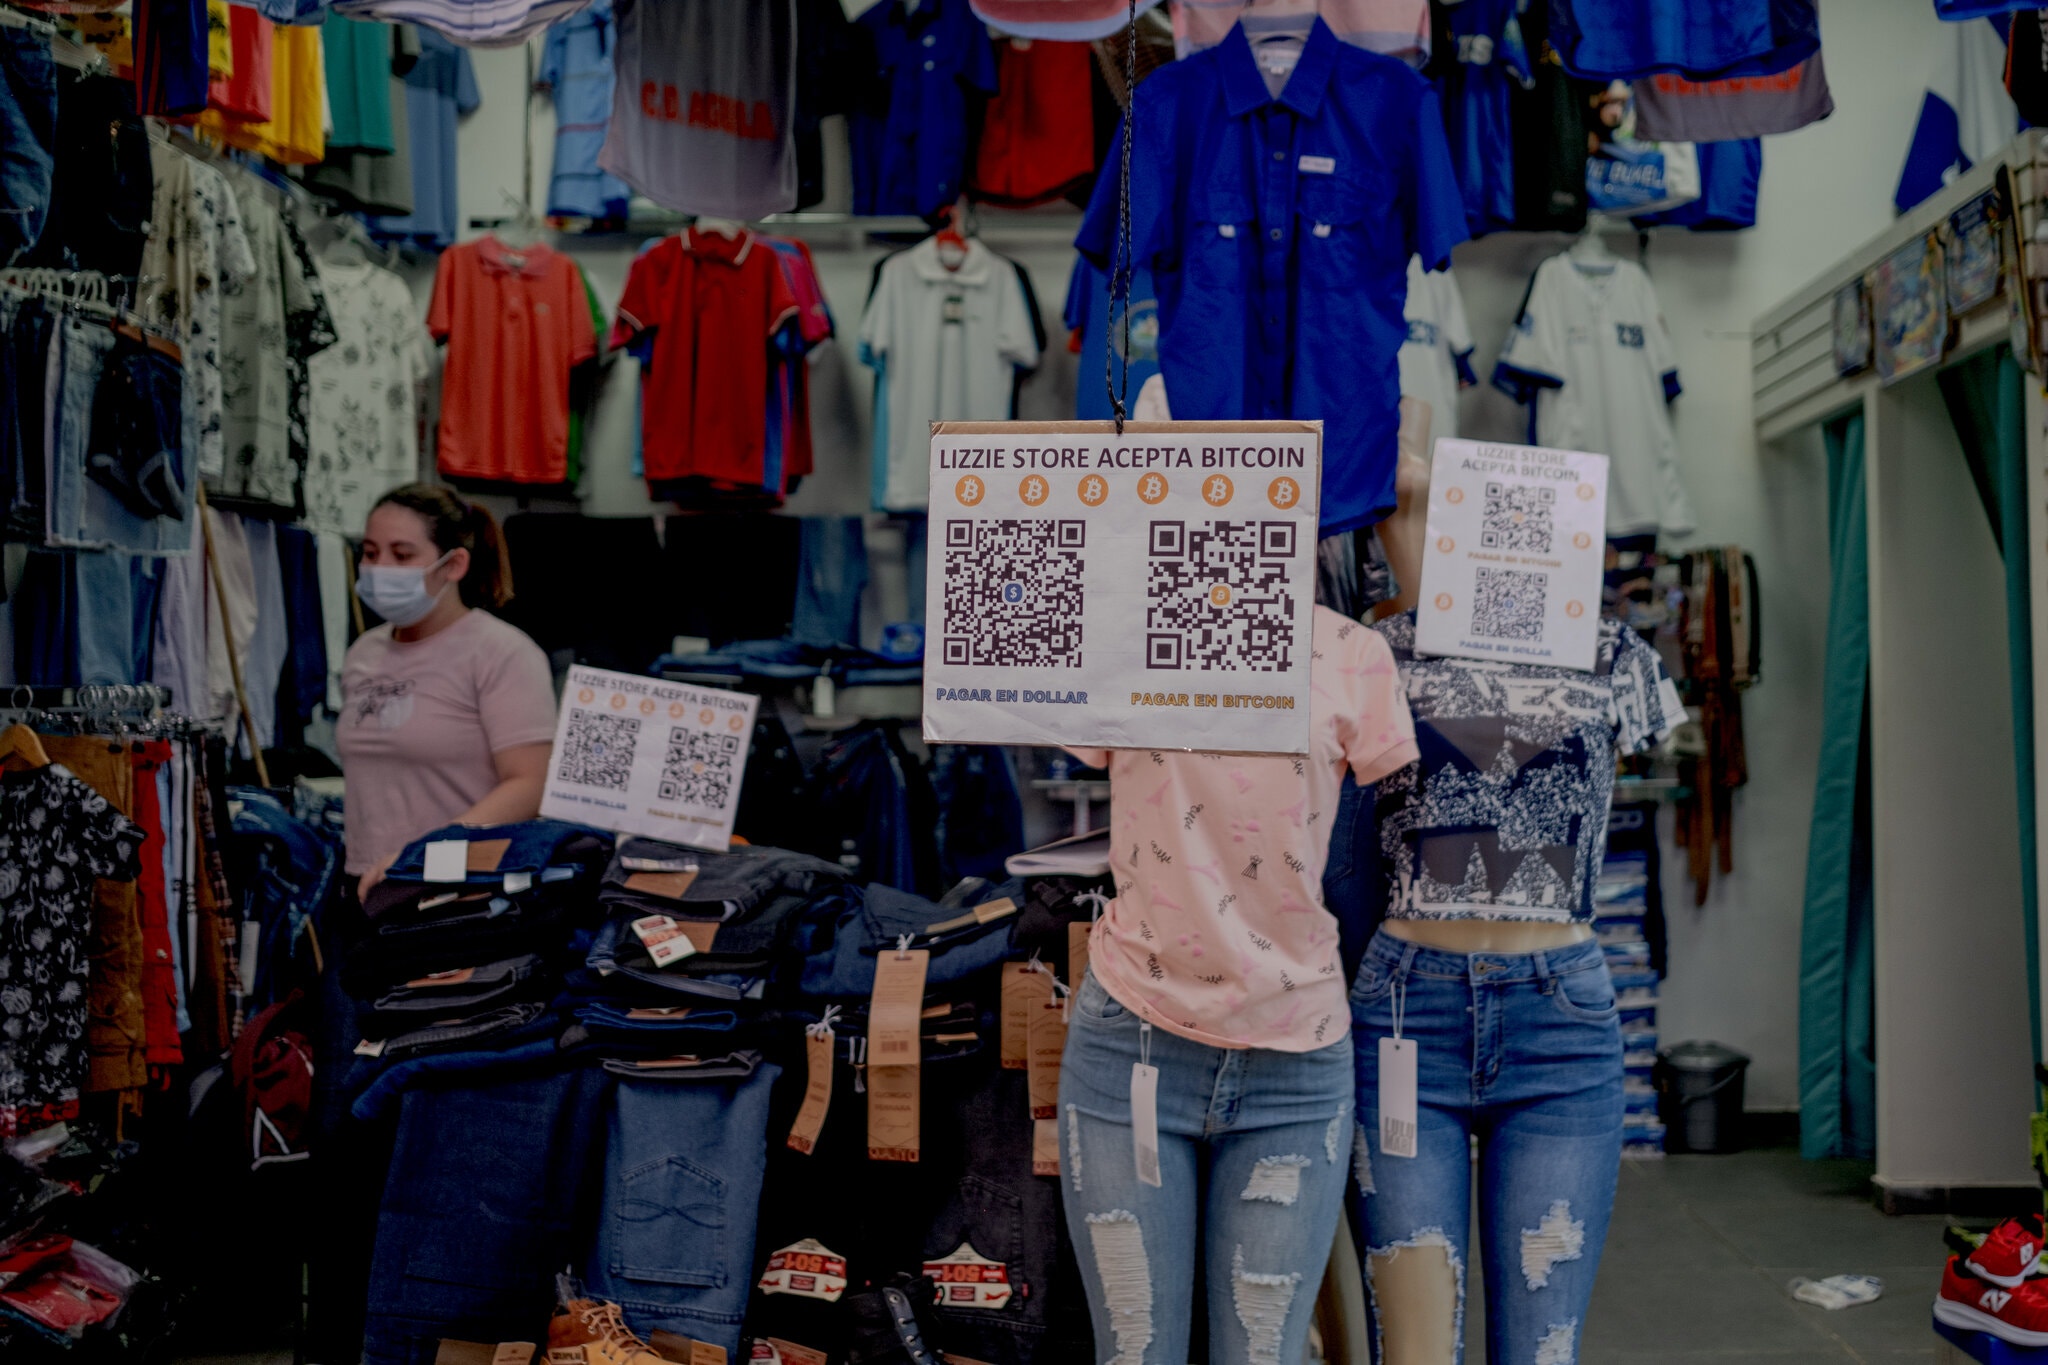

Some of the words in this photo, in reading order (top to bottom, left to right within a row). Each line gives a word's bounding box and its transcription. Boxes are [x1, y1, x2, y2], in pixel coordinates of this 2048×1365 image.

[940, 448, 1005, 470] LIZZIE
[1012, 447, 1090, 469] STORE
[1097, 447, 1194, 469] ACEPTA
[1201, 446, 1305, 469] BITCOIN
[1477, 446, 1516, 461] LIZZIE
[1521, 451, 1567, 466] STORE
[1461, 458, 1516, 475] ACEPTA
[1521, 465, 1580, 482] BITCOIN
[1459, 640, 1493, 651] PAGAR
[1495, 643, 1509, 653] EN
[1512, 645, 1552, 657] DOLLAR
[573, 672, 607, 689] LIZZIE
[610, 678, 648, 695] STORE
[652, 685, 698, 704] ACEPTA
[701, 694, 749, 712] BITCOIN
[936, 688, 991, 702] PAGAR
[996, 690, 1018, 703] EN
[1022, 690, 1088, 705] DOLLAR
[1130, 692, 1189, 707] PAGAR
[1194, 694, 1217, 708] EN
[1222, 694, 1295, 710] BITCOIN
[783, 1252, 823, 1272] 501
[941, 1264, 980, 1282] 501
